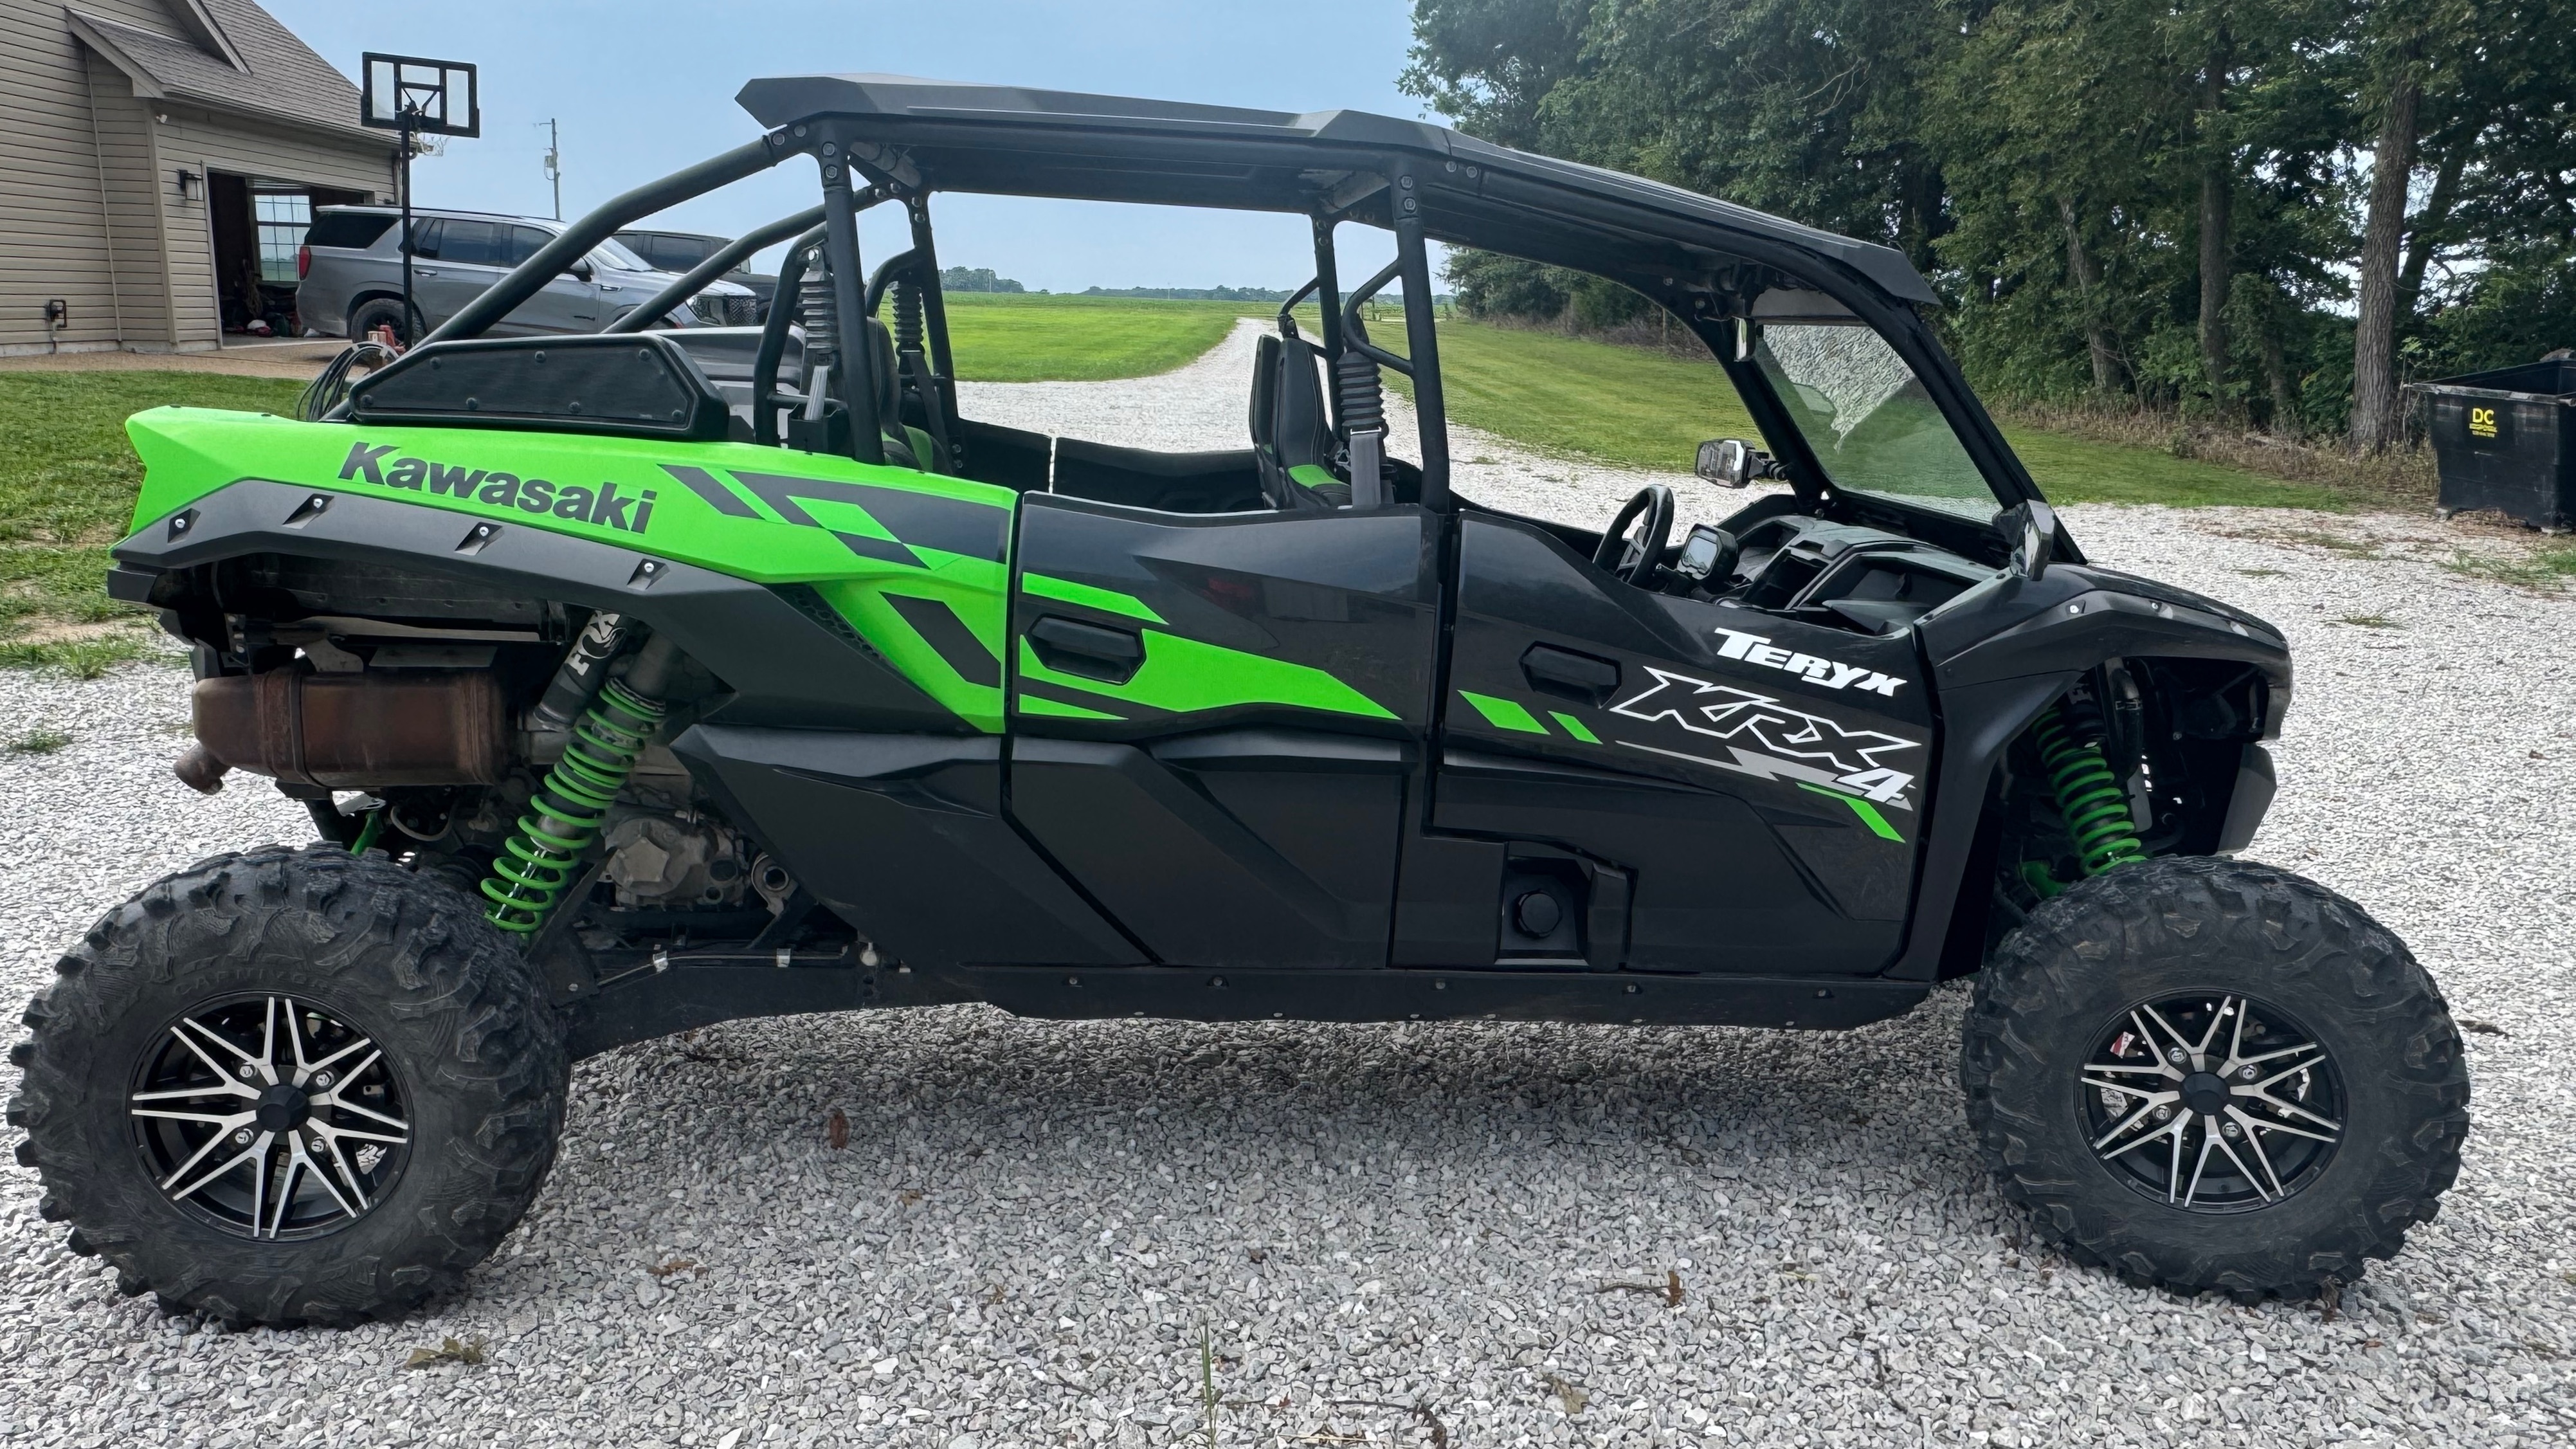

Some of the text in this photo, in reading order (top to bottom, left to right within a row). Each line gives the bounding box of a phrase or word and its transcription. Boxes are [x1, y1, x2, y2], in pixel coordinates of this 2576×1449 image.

[2472, 408, 2494, 424] DC
[338, 441, 657, 534] Kawasaki
[565, 610, 628, 676] FOX
[1609, 665, 1923, 803] KRX 4
